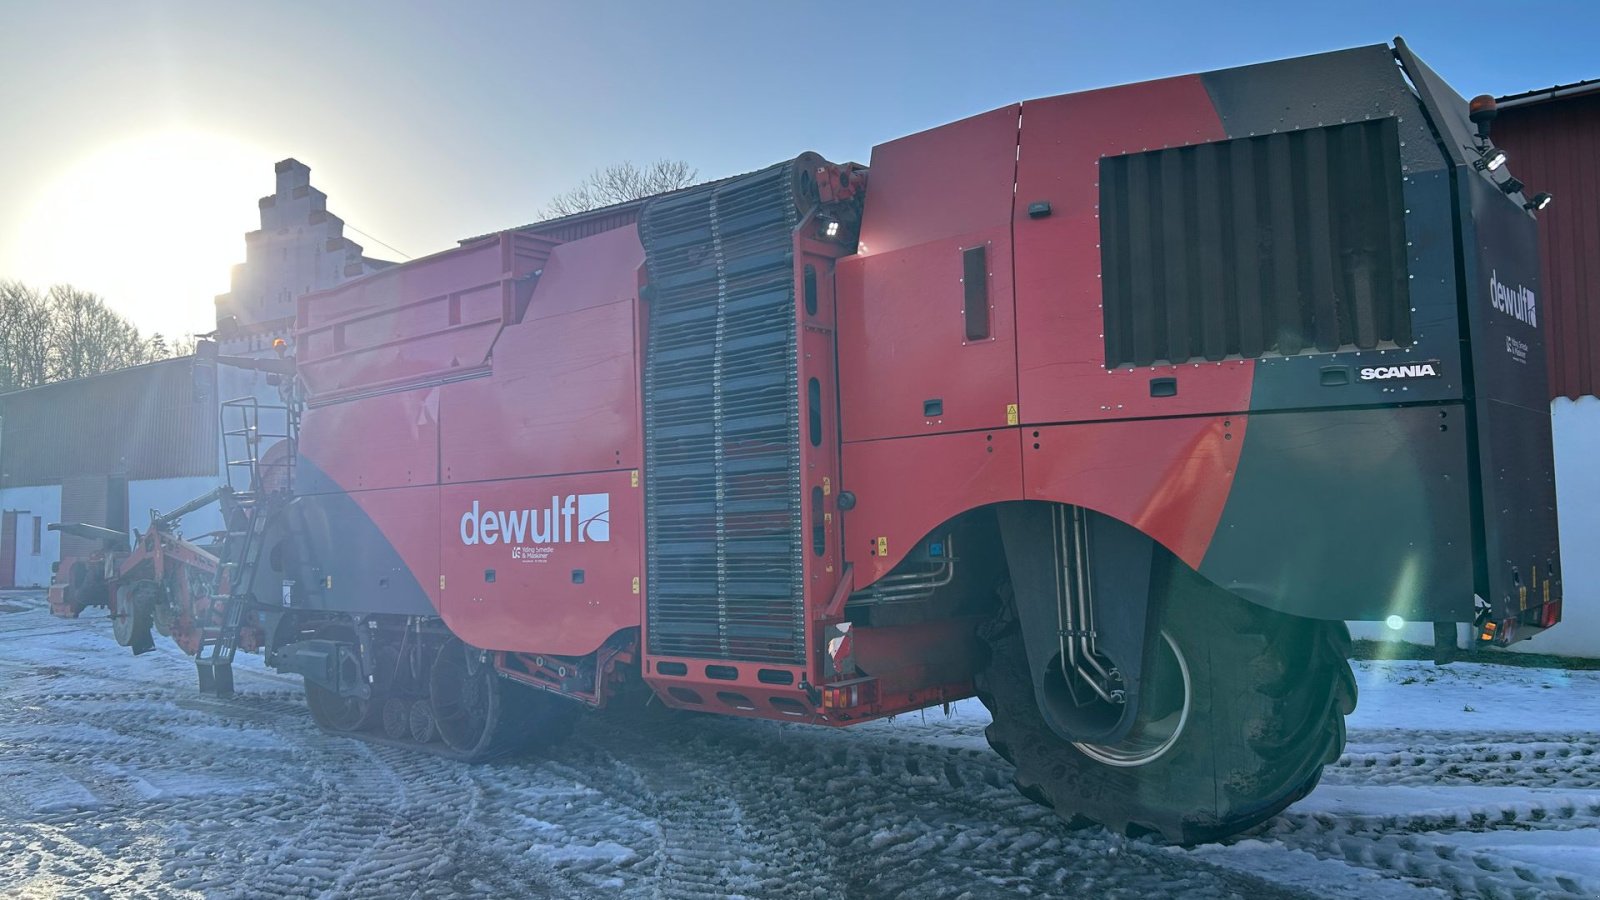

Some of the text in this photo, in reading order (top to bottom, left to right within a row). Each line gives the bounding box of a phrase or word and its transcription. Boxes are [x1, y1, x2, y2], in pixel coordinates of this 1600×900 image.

[1490, 268, 1528, 323] dewulf
[1360, 364, 1436, 380] SCANIA
[460, 494, 575, 545] dewulf
